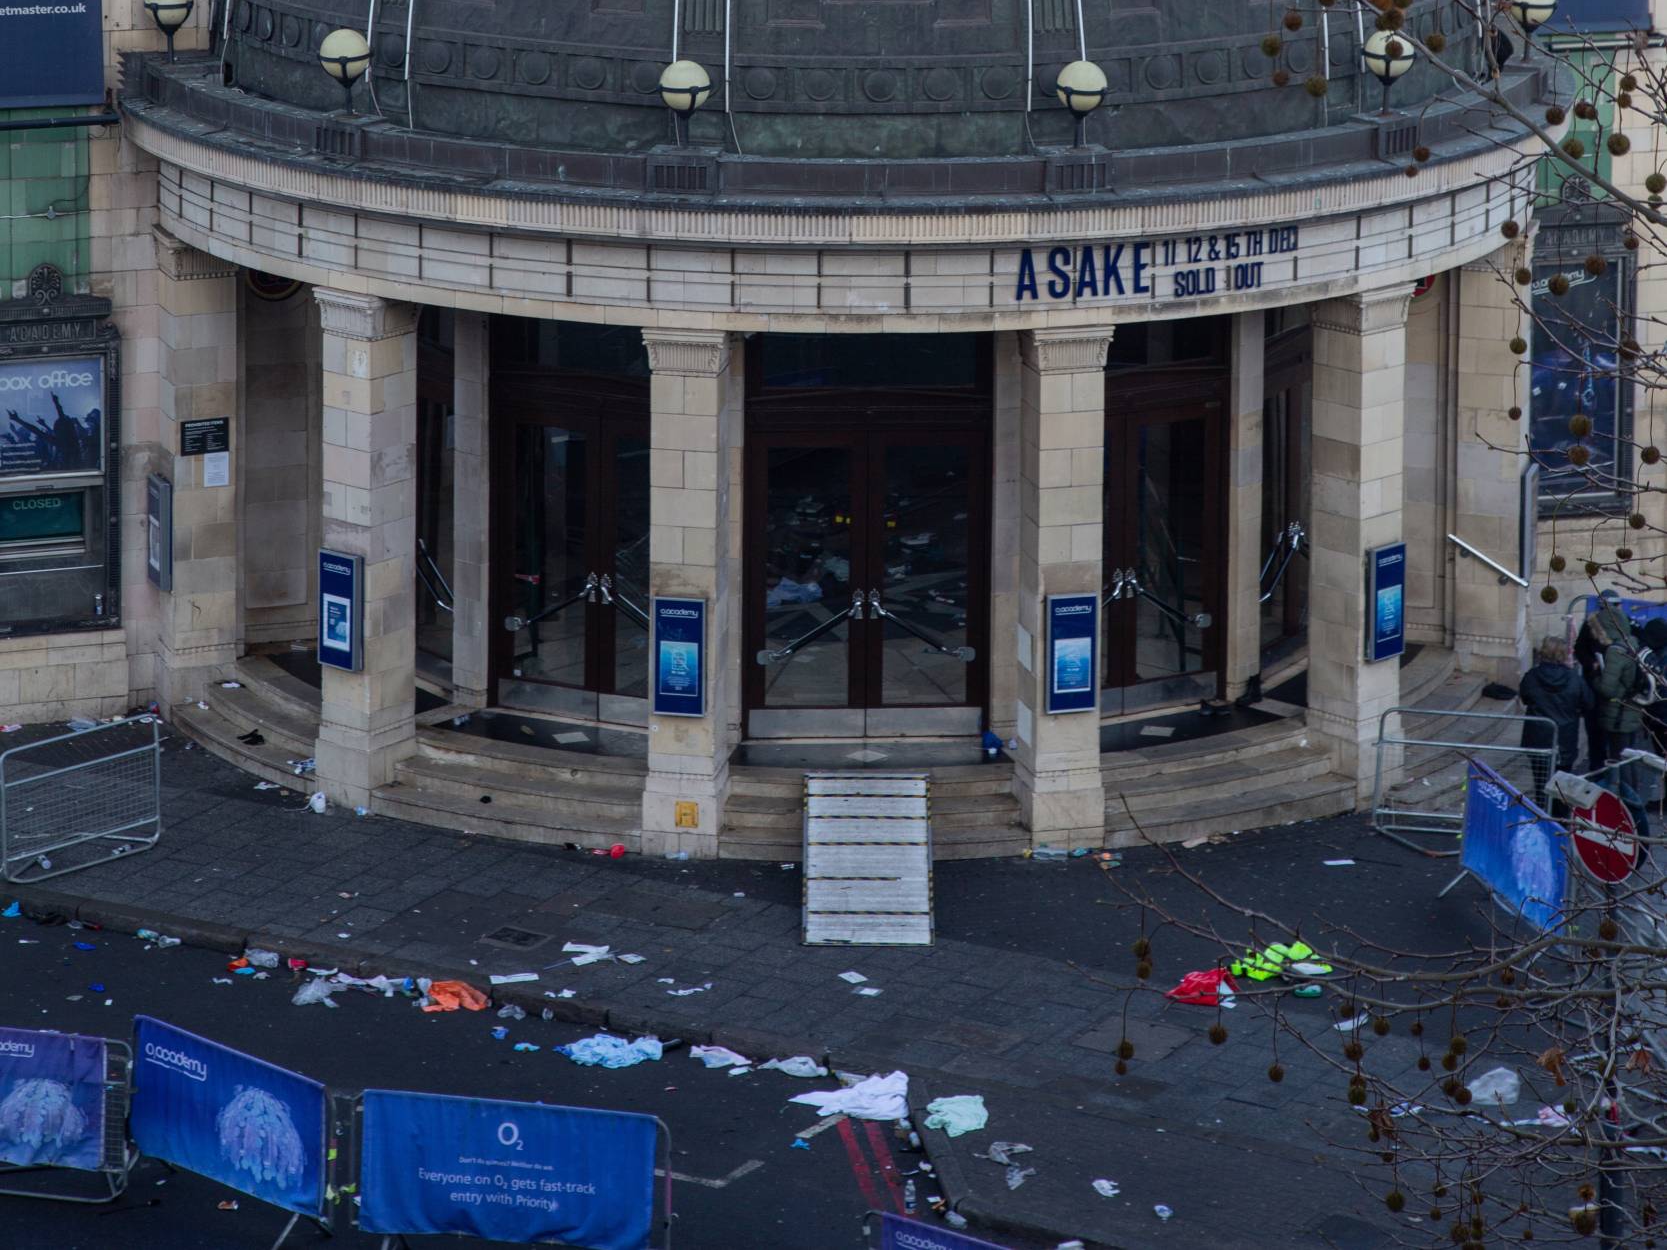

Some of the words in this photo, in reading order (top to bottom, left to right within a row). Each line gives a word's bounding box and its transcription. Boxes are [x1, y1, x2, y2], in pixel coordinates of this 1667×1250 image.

[1185, 236, 1202, 263] 12
[1208, 234, 1221, 261] &
[1015, 241, 1151, 301] ASAKE
[1173, 266, 1216, 298] SOLD
[1234, 261, 1264, 290] OUT
[9, 322, 81, 342] ACADEMY
[38, 370, 93, 389] office
[13, 498, 62, 510] CLOSED
[497, 1122, 524, 1151] O2
[418, 1167, 471, 1185] Everyone
[474, 1174, 490, 1184] on
[511, 1177, 537, 1191] gets
[540, 1178, 596, 1195] fast-track
[450, 1191, 482, 1205] entry
[485, 1192, 513, 1205] with
[516, 1196, 555, 1212] Priority
